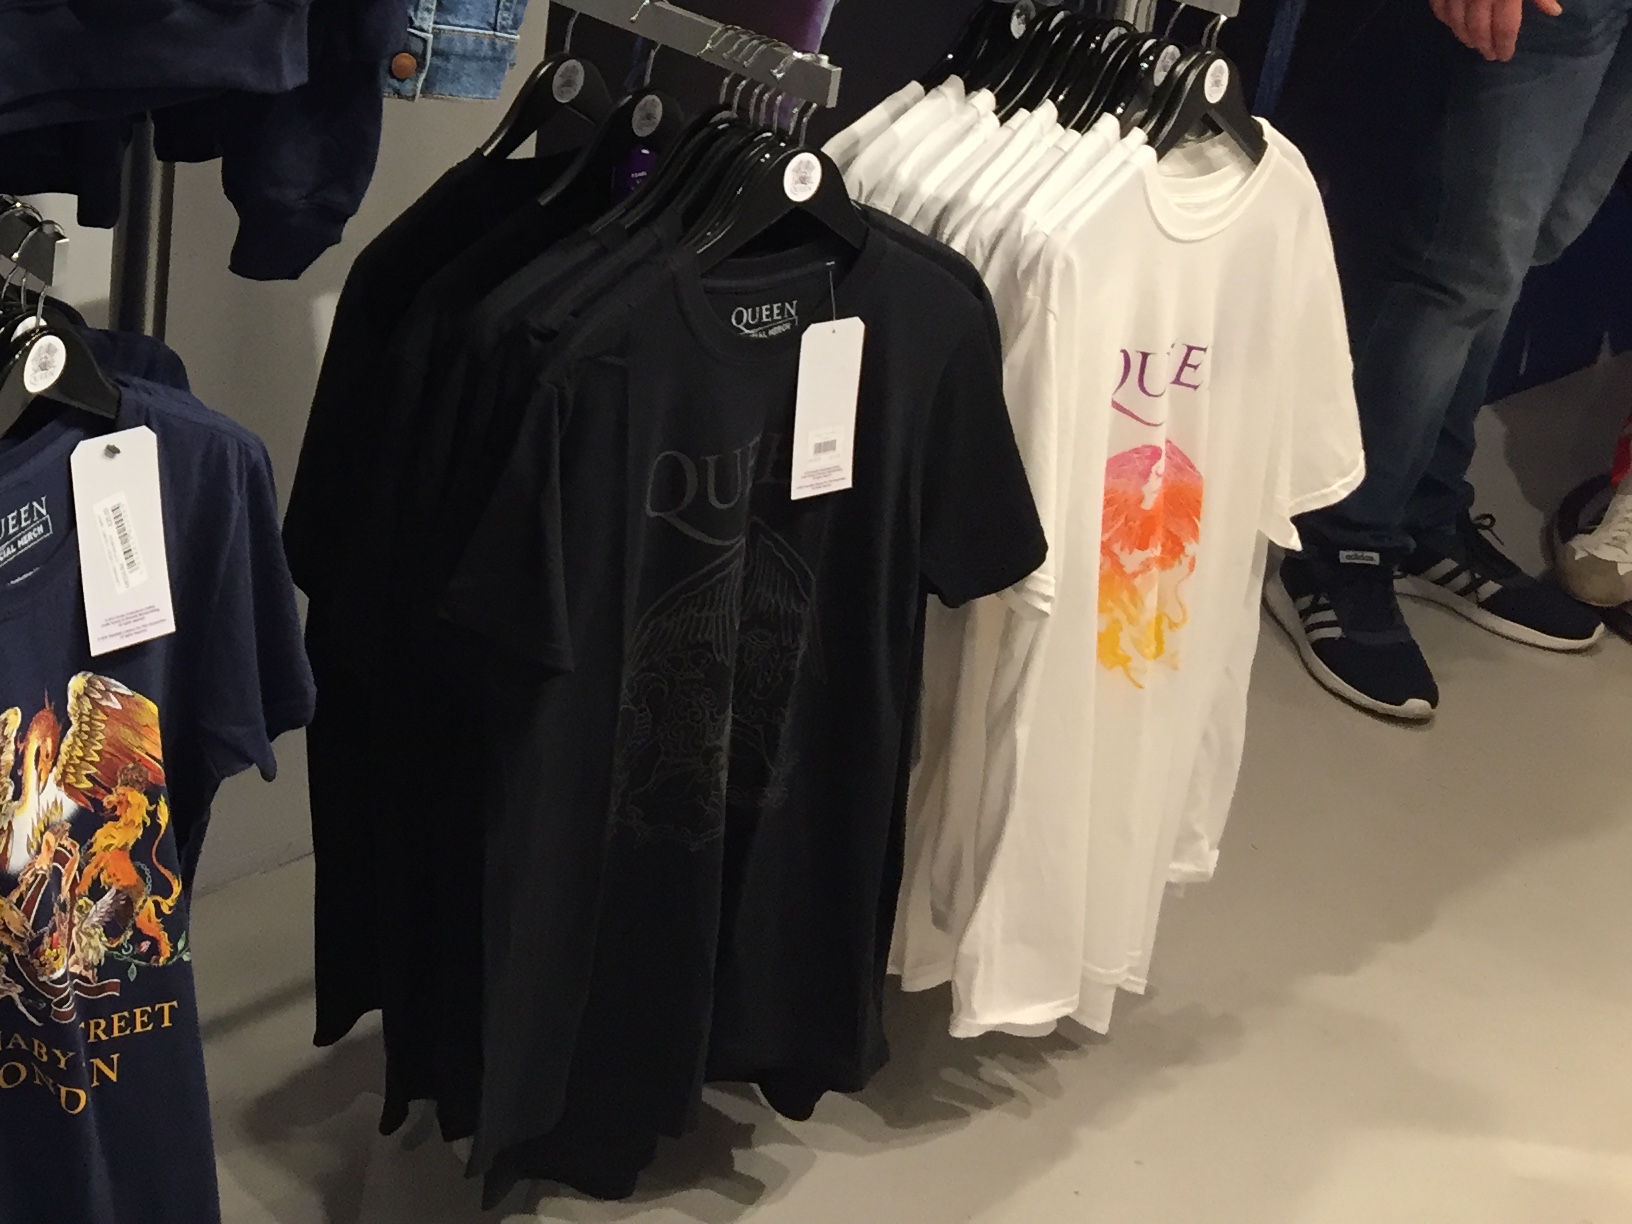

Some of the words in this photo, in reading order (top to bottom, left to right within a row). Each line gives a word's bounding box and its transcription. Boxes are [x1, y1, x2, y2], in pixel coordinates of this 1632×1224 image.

[730, 299, 799, 335] QUEEN
[17, 523, 45, 548] MERCH
[78, 1000, 179, 1044] REET
